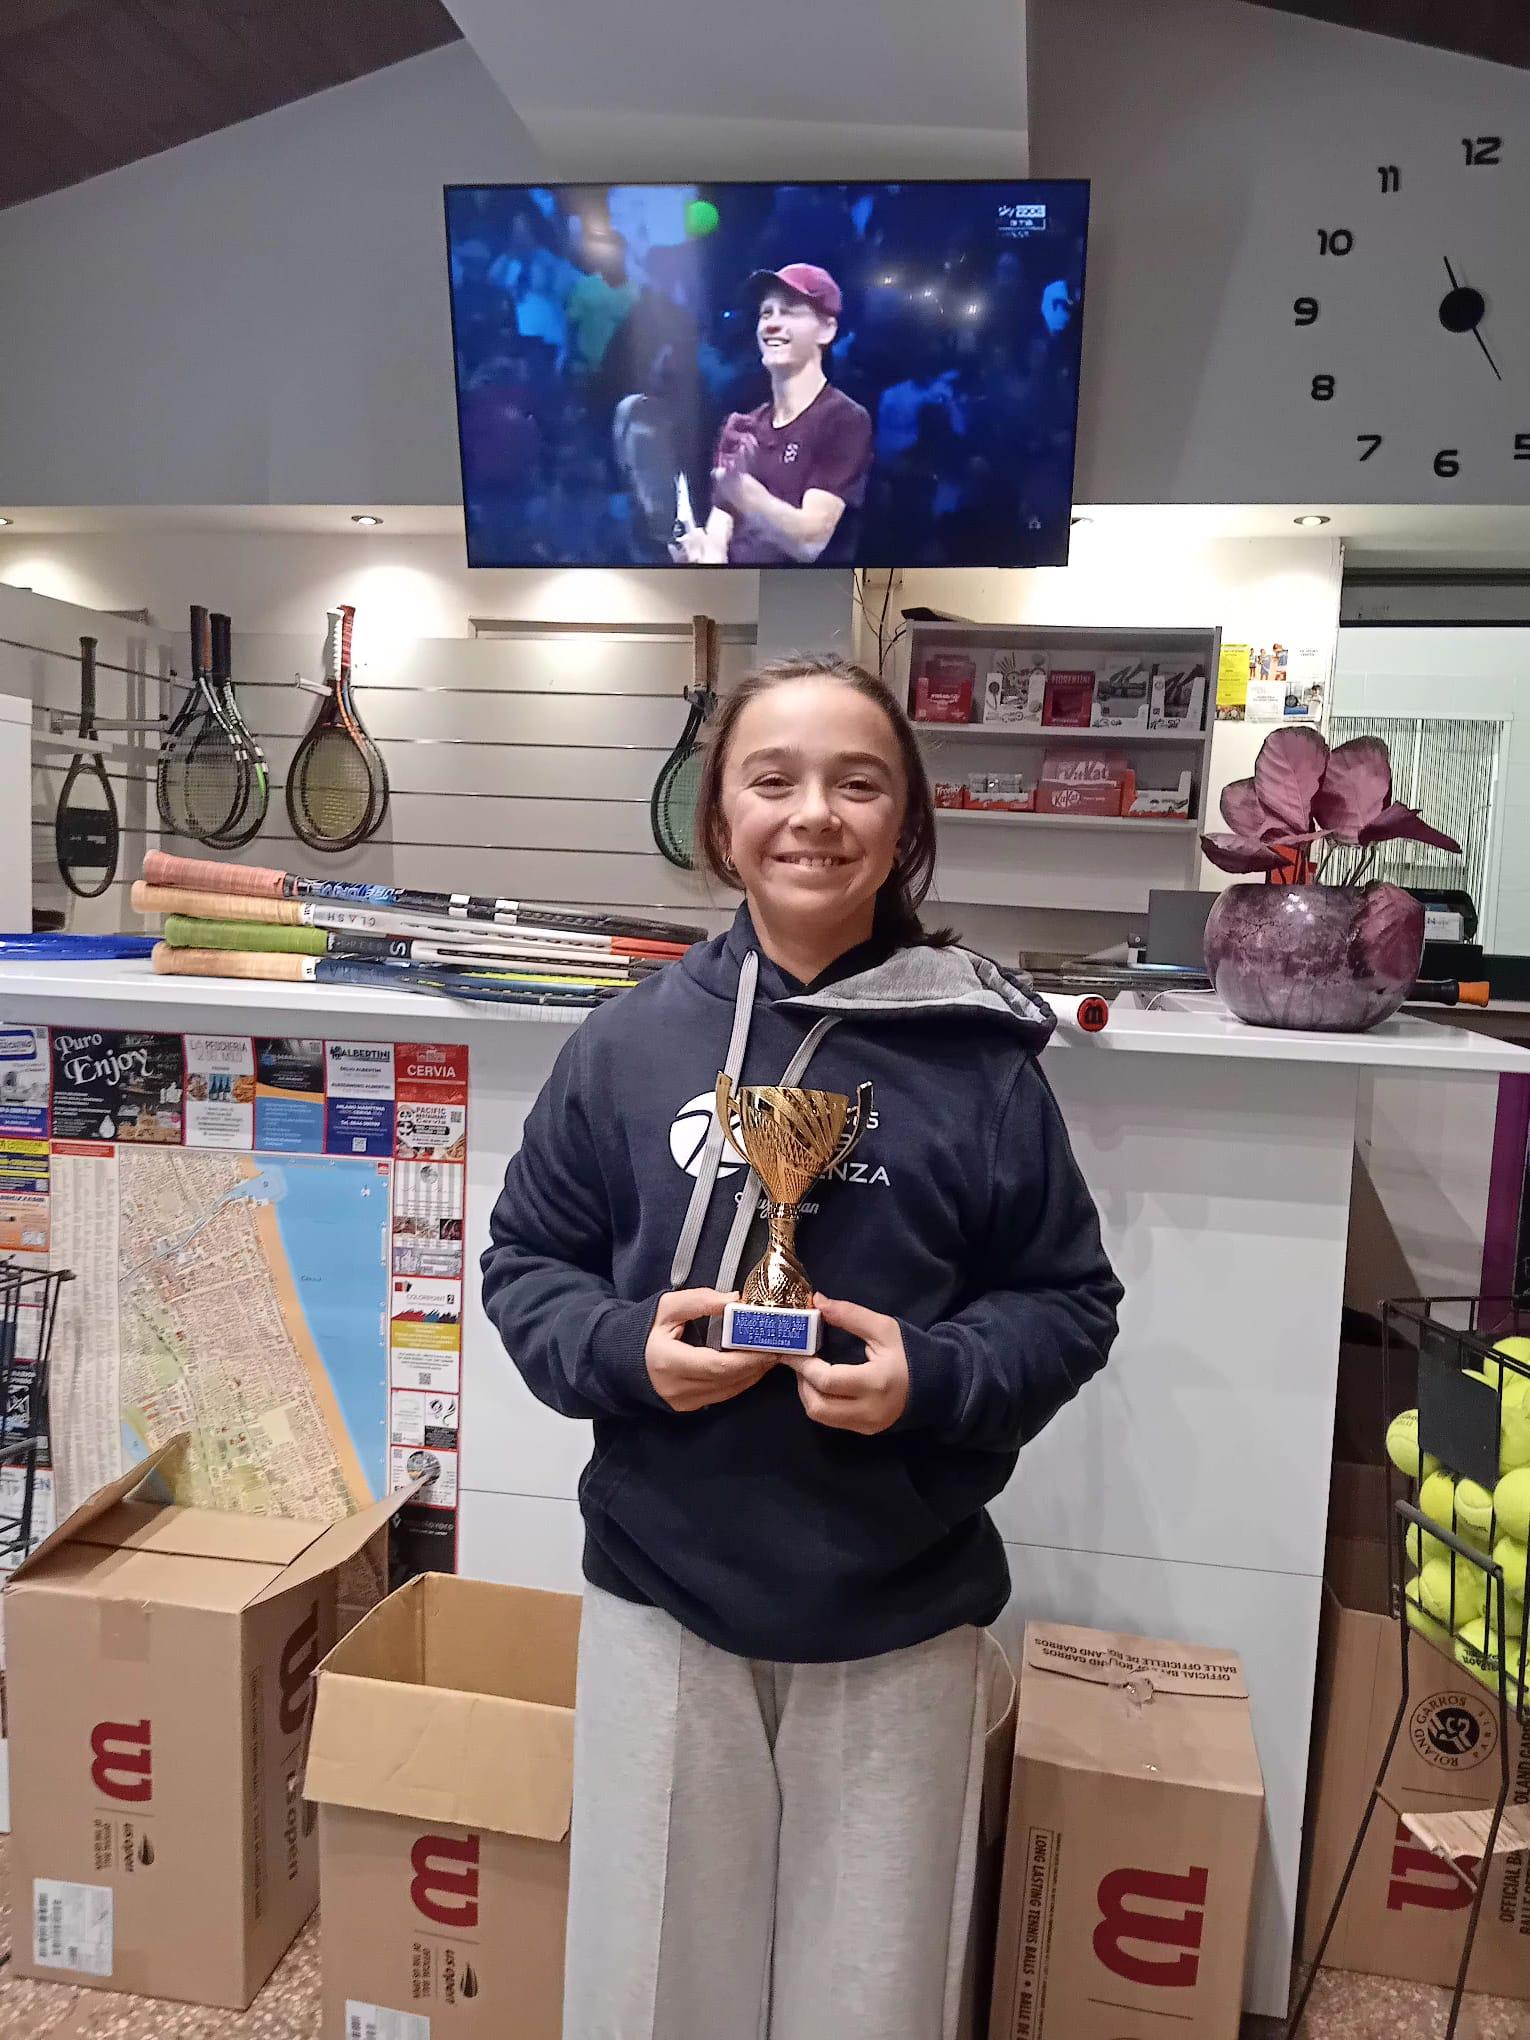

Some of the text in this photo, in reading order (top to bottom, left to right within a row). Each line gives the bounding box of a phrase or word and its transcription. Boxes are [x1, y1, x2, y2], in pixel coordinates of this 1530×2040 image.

[1462, 136, 1502, 166] 12
[1378, 165, 1401, 193] 11
[1318, 229, 1354, 256] 10
[1293, 297, 1319, 326] 9
[1311, 374, 1335, 401] 8
[1357, 435, 1382, 461] 7
[1433, 449, 1460, 478] 6
[327, 911, 376, 927] CLASH
[55, 1033, 103, 1061] Puro
[341, 1048, 391, 1060] ALBERTINI
[64, 1048, 154, 1086] Enjoy
[407, 1064, 456, 1078] CERVIA
[1035, 1638, 1077, 1655] GARROS
[1042, 1647, 1087, 1664] GARROS
[1142, 1657, 1201, 1672] OFFICIELLE
[1180, 1671, 1231, 1682] OFFICIAL
[1203, 1663, 1237, 1675] BALLE
[1416, 1695, 1467, 1725] GARROS
[1413, 1728, 1459, 1768] ROLAND
[1499, 1866, 1521, 1924] OFFICIAL
[1016, 1834, 1048, 2035] LONG LASTING TENNIS BALLS BALLE DE
